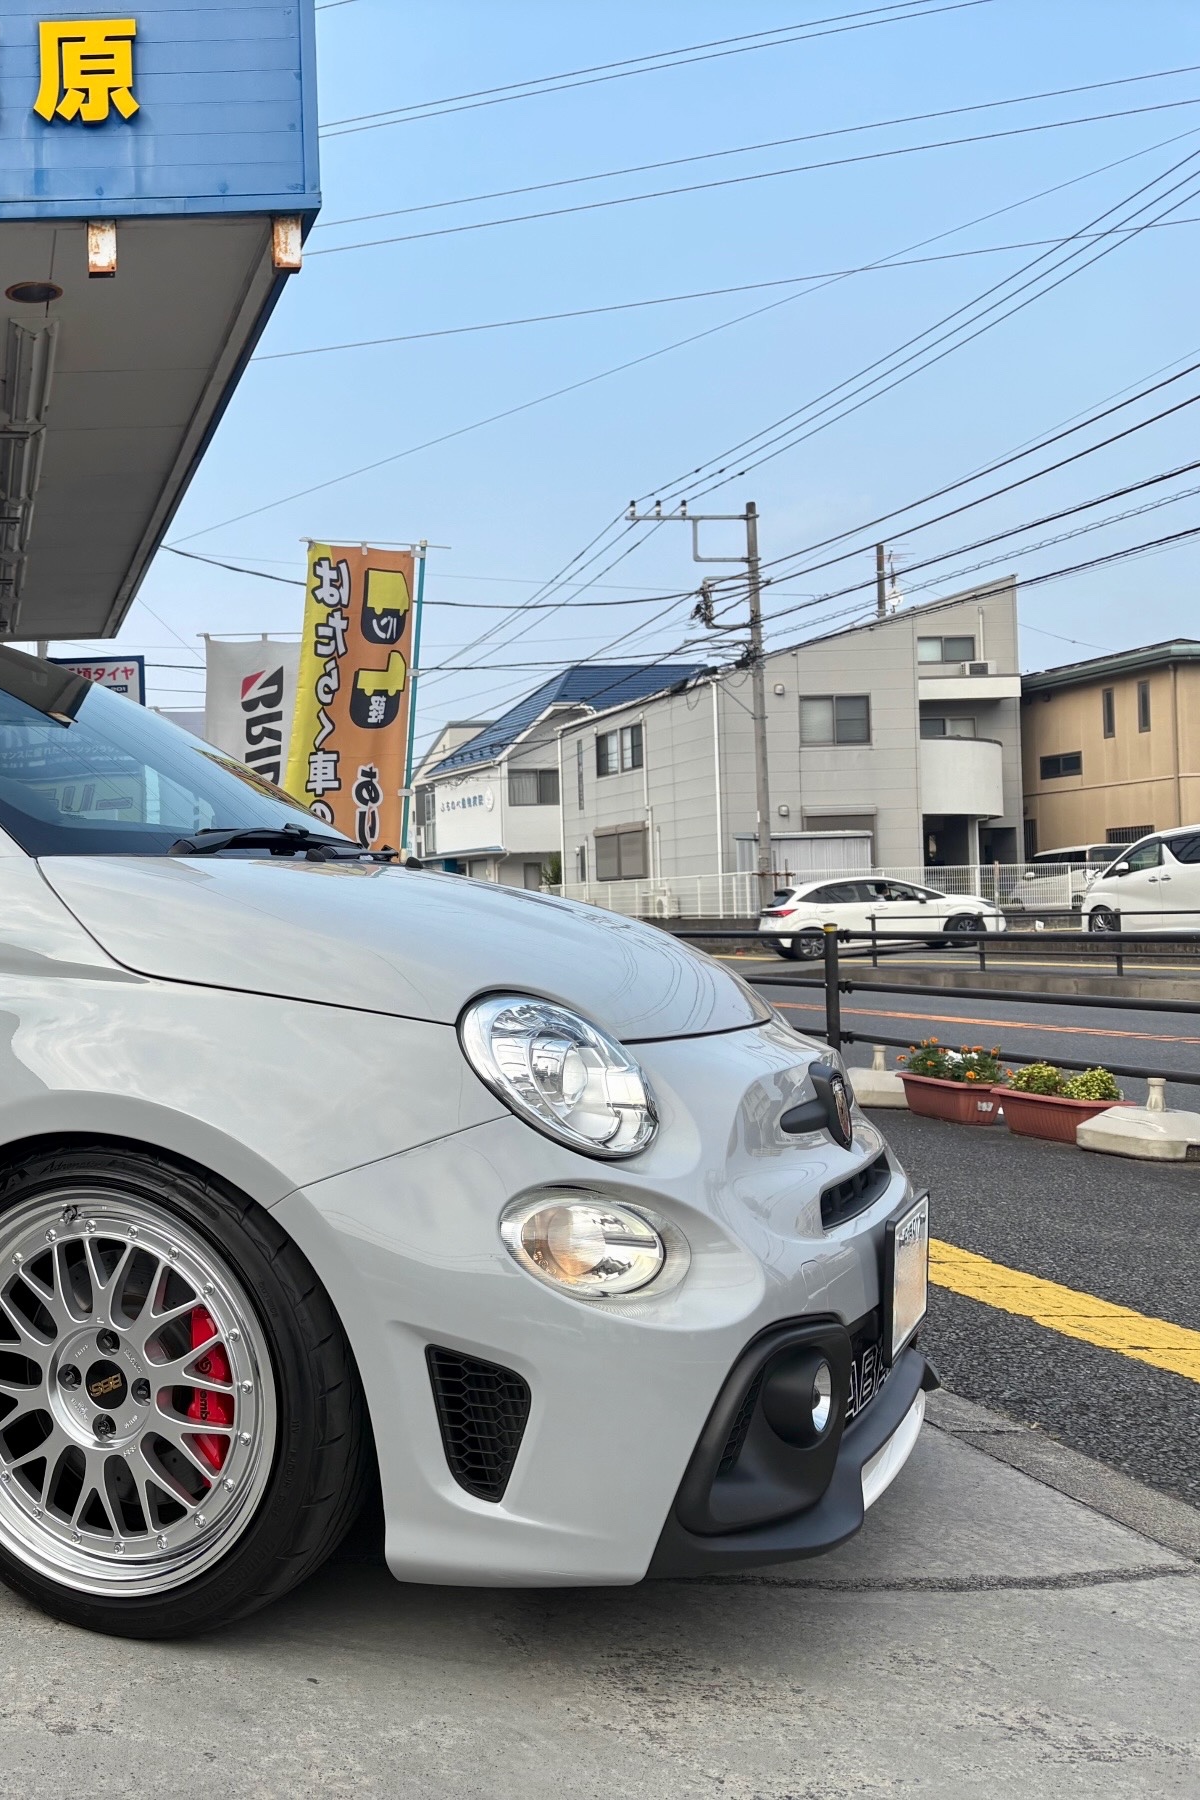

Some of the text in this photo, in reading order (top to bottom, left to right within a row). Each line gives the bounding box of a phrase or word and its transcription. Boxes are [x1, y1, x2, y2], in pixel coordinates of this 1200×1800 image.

[68, 666, 135, 682] 頃タイヤ
[90, 1373, 123, 1397] BBS
